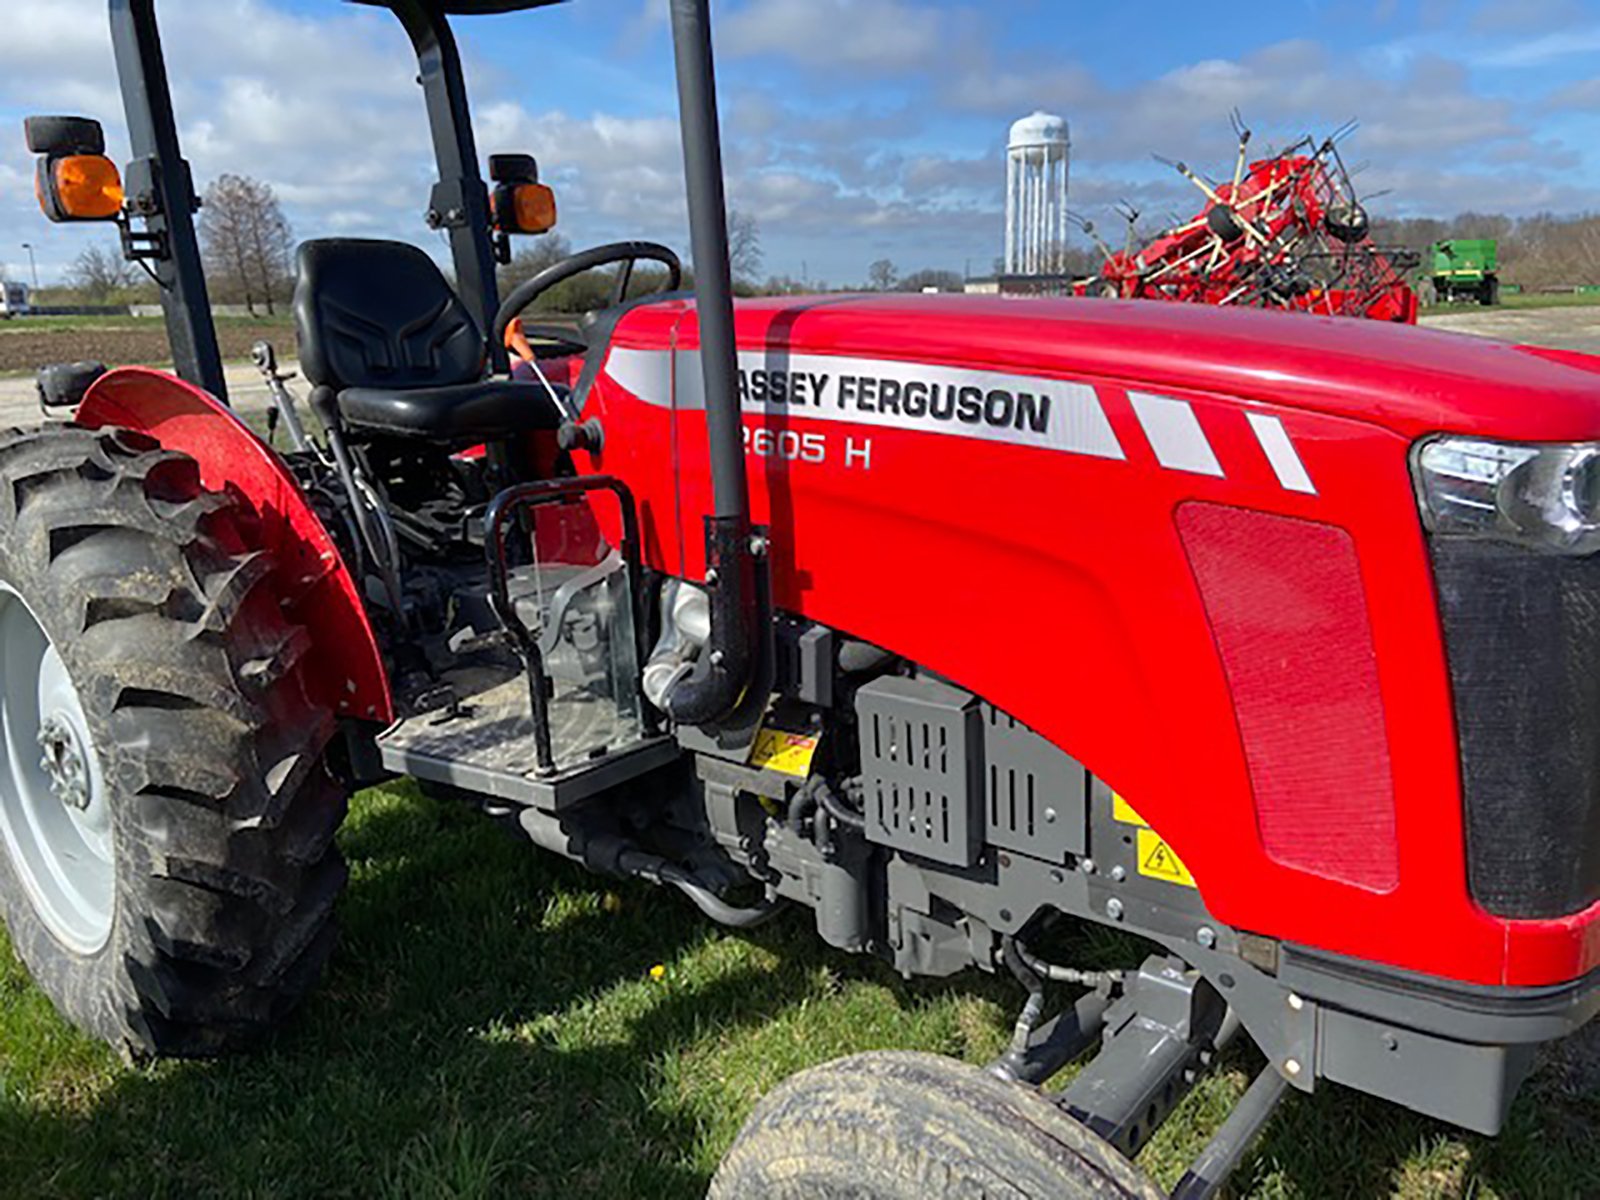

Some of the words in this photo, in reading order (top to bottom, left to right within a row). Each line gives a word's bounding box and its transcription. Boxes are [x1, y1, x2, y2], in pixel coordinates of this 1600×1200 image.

[738, 369, 829, 407] ASSEY
[838, 375, 1051, 434] FERGUSON
[845, 437, 872, 469] H
